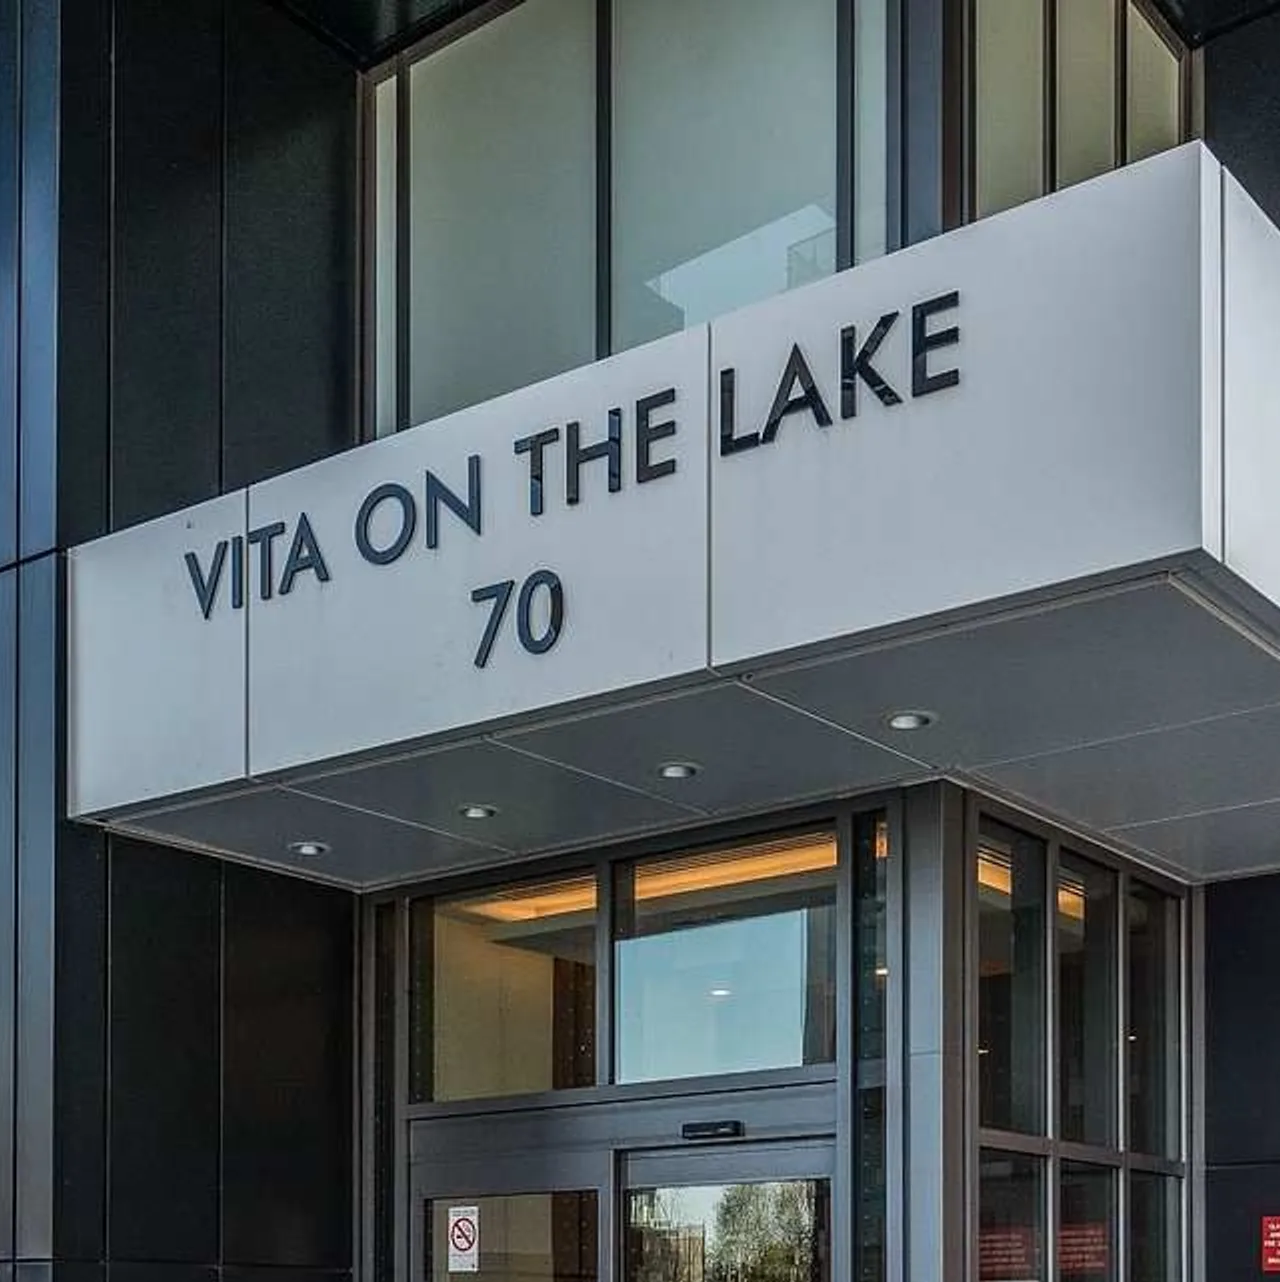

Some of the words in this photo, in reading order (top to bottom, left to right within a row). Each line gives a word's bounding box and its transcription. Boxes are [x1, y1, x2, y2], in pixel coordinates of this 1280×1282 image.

[185, 511, 331, 621] VITA
[355, 454, 482, 565] ON
[514, 387, 677, 516] THE
[720, 290, 961, 457] LAKE
[471, 569, 565, 669] 70
